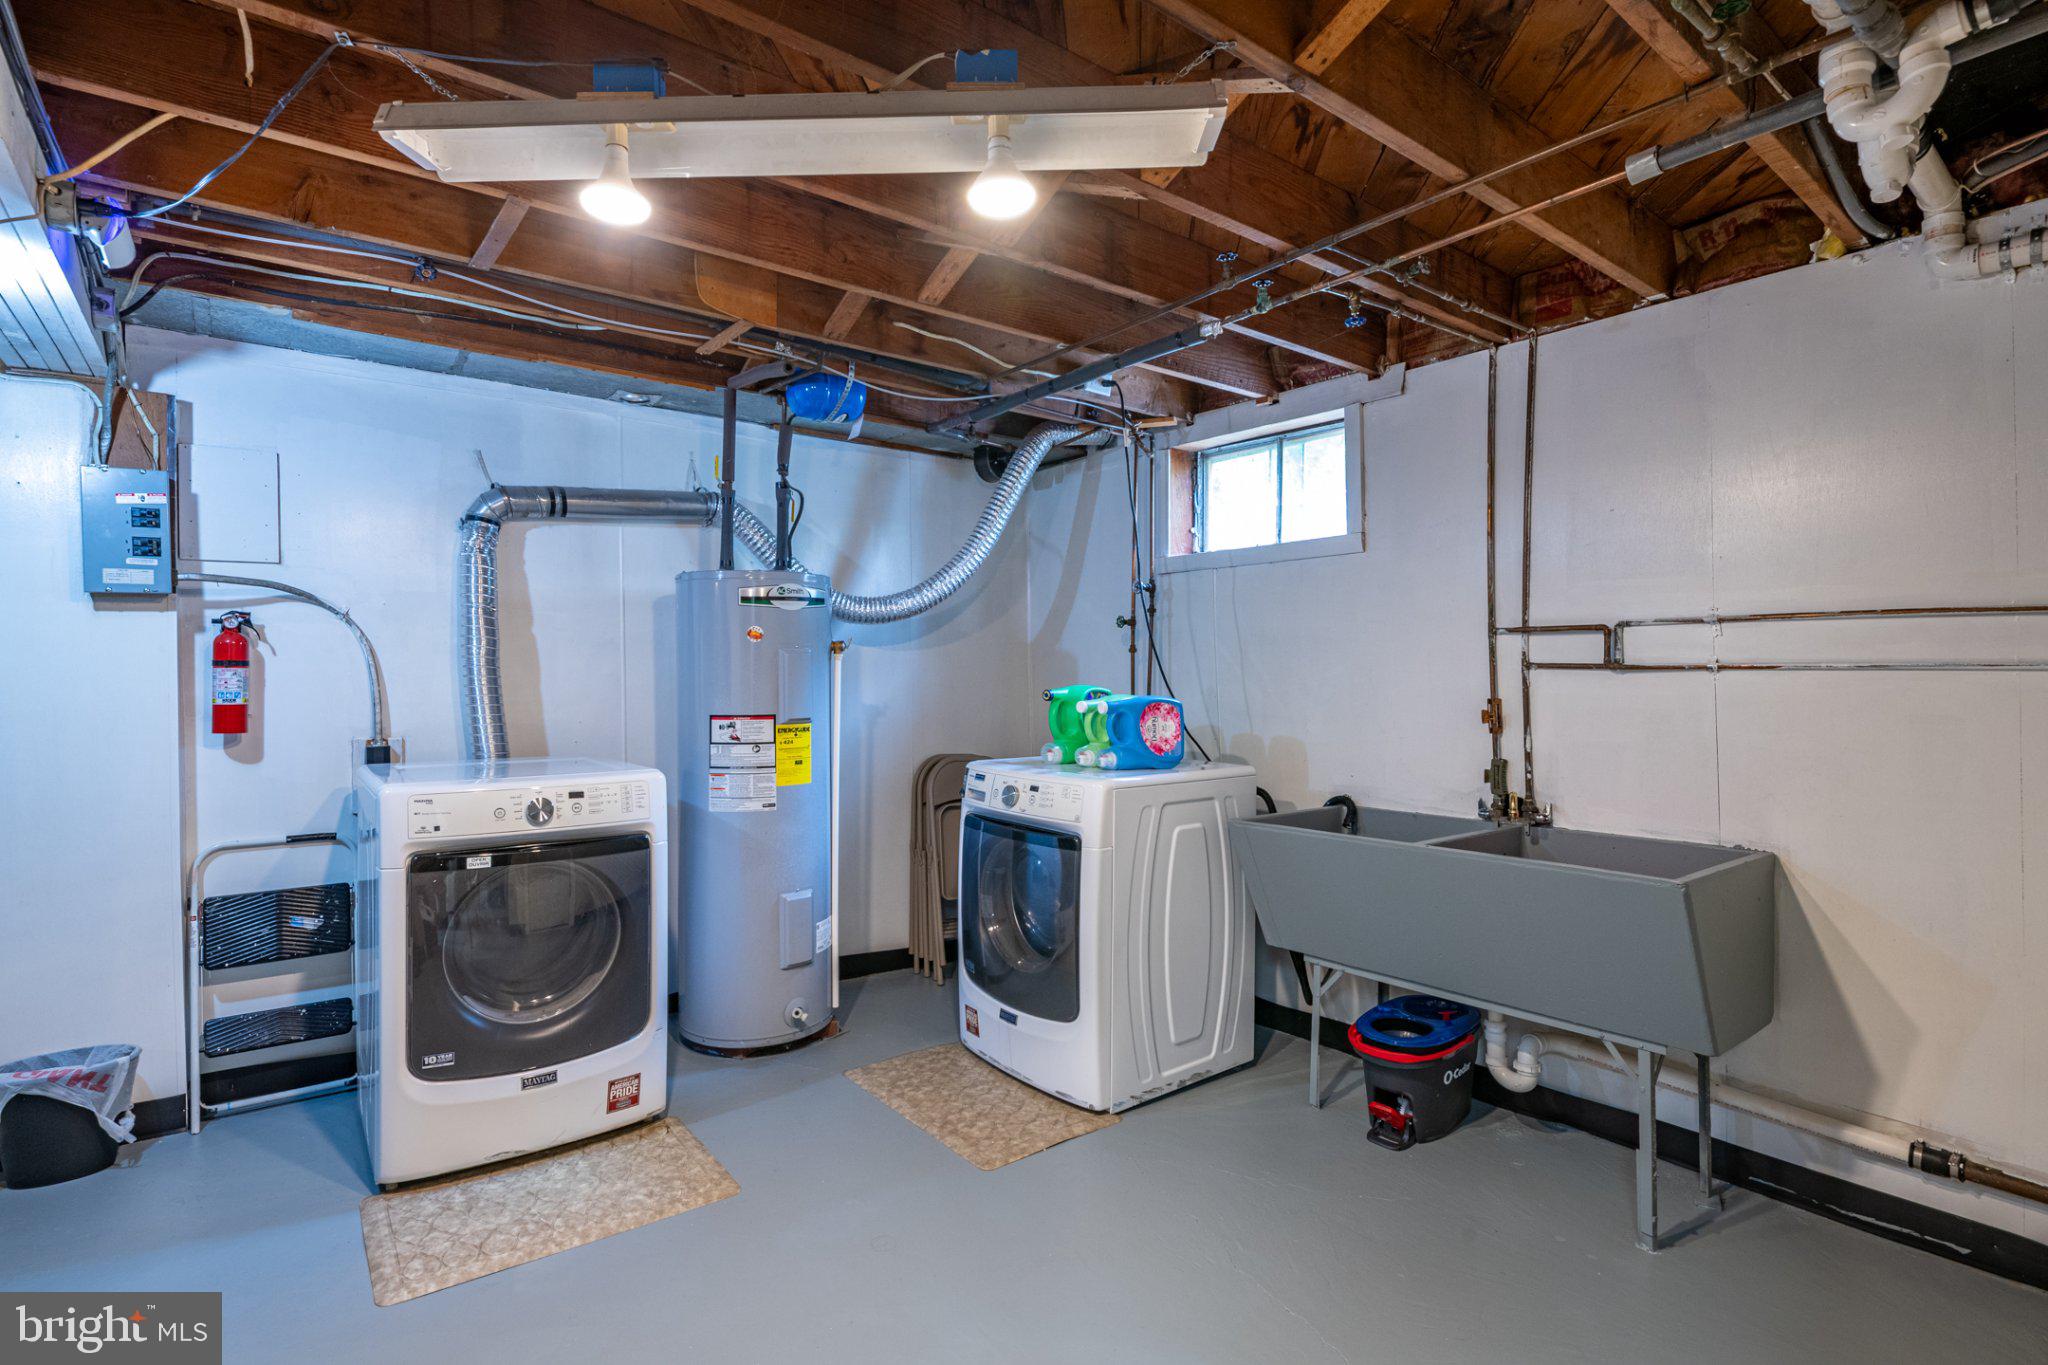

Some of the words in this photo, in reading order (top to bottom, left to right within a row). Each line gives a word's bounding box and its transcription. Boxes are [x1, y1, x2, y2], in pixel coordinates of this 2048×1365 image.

[424, 1056, 437, 1065] 10
[523, 1073, 556, 1087] MAYTAG
[609, 1084, 638, 1100] PRIDE
